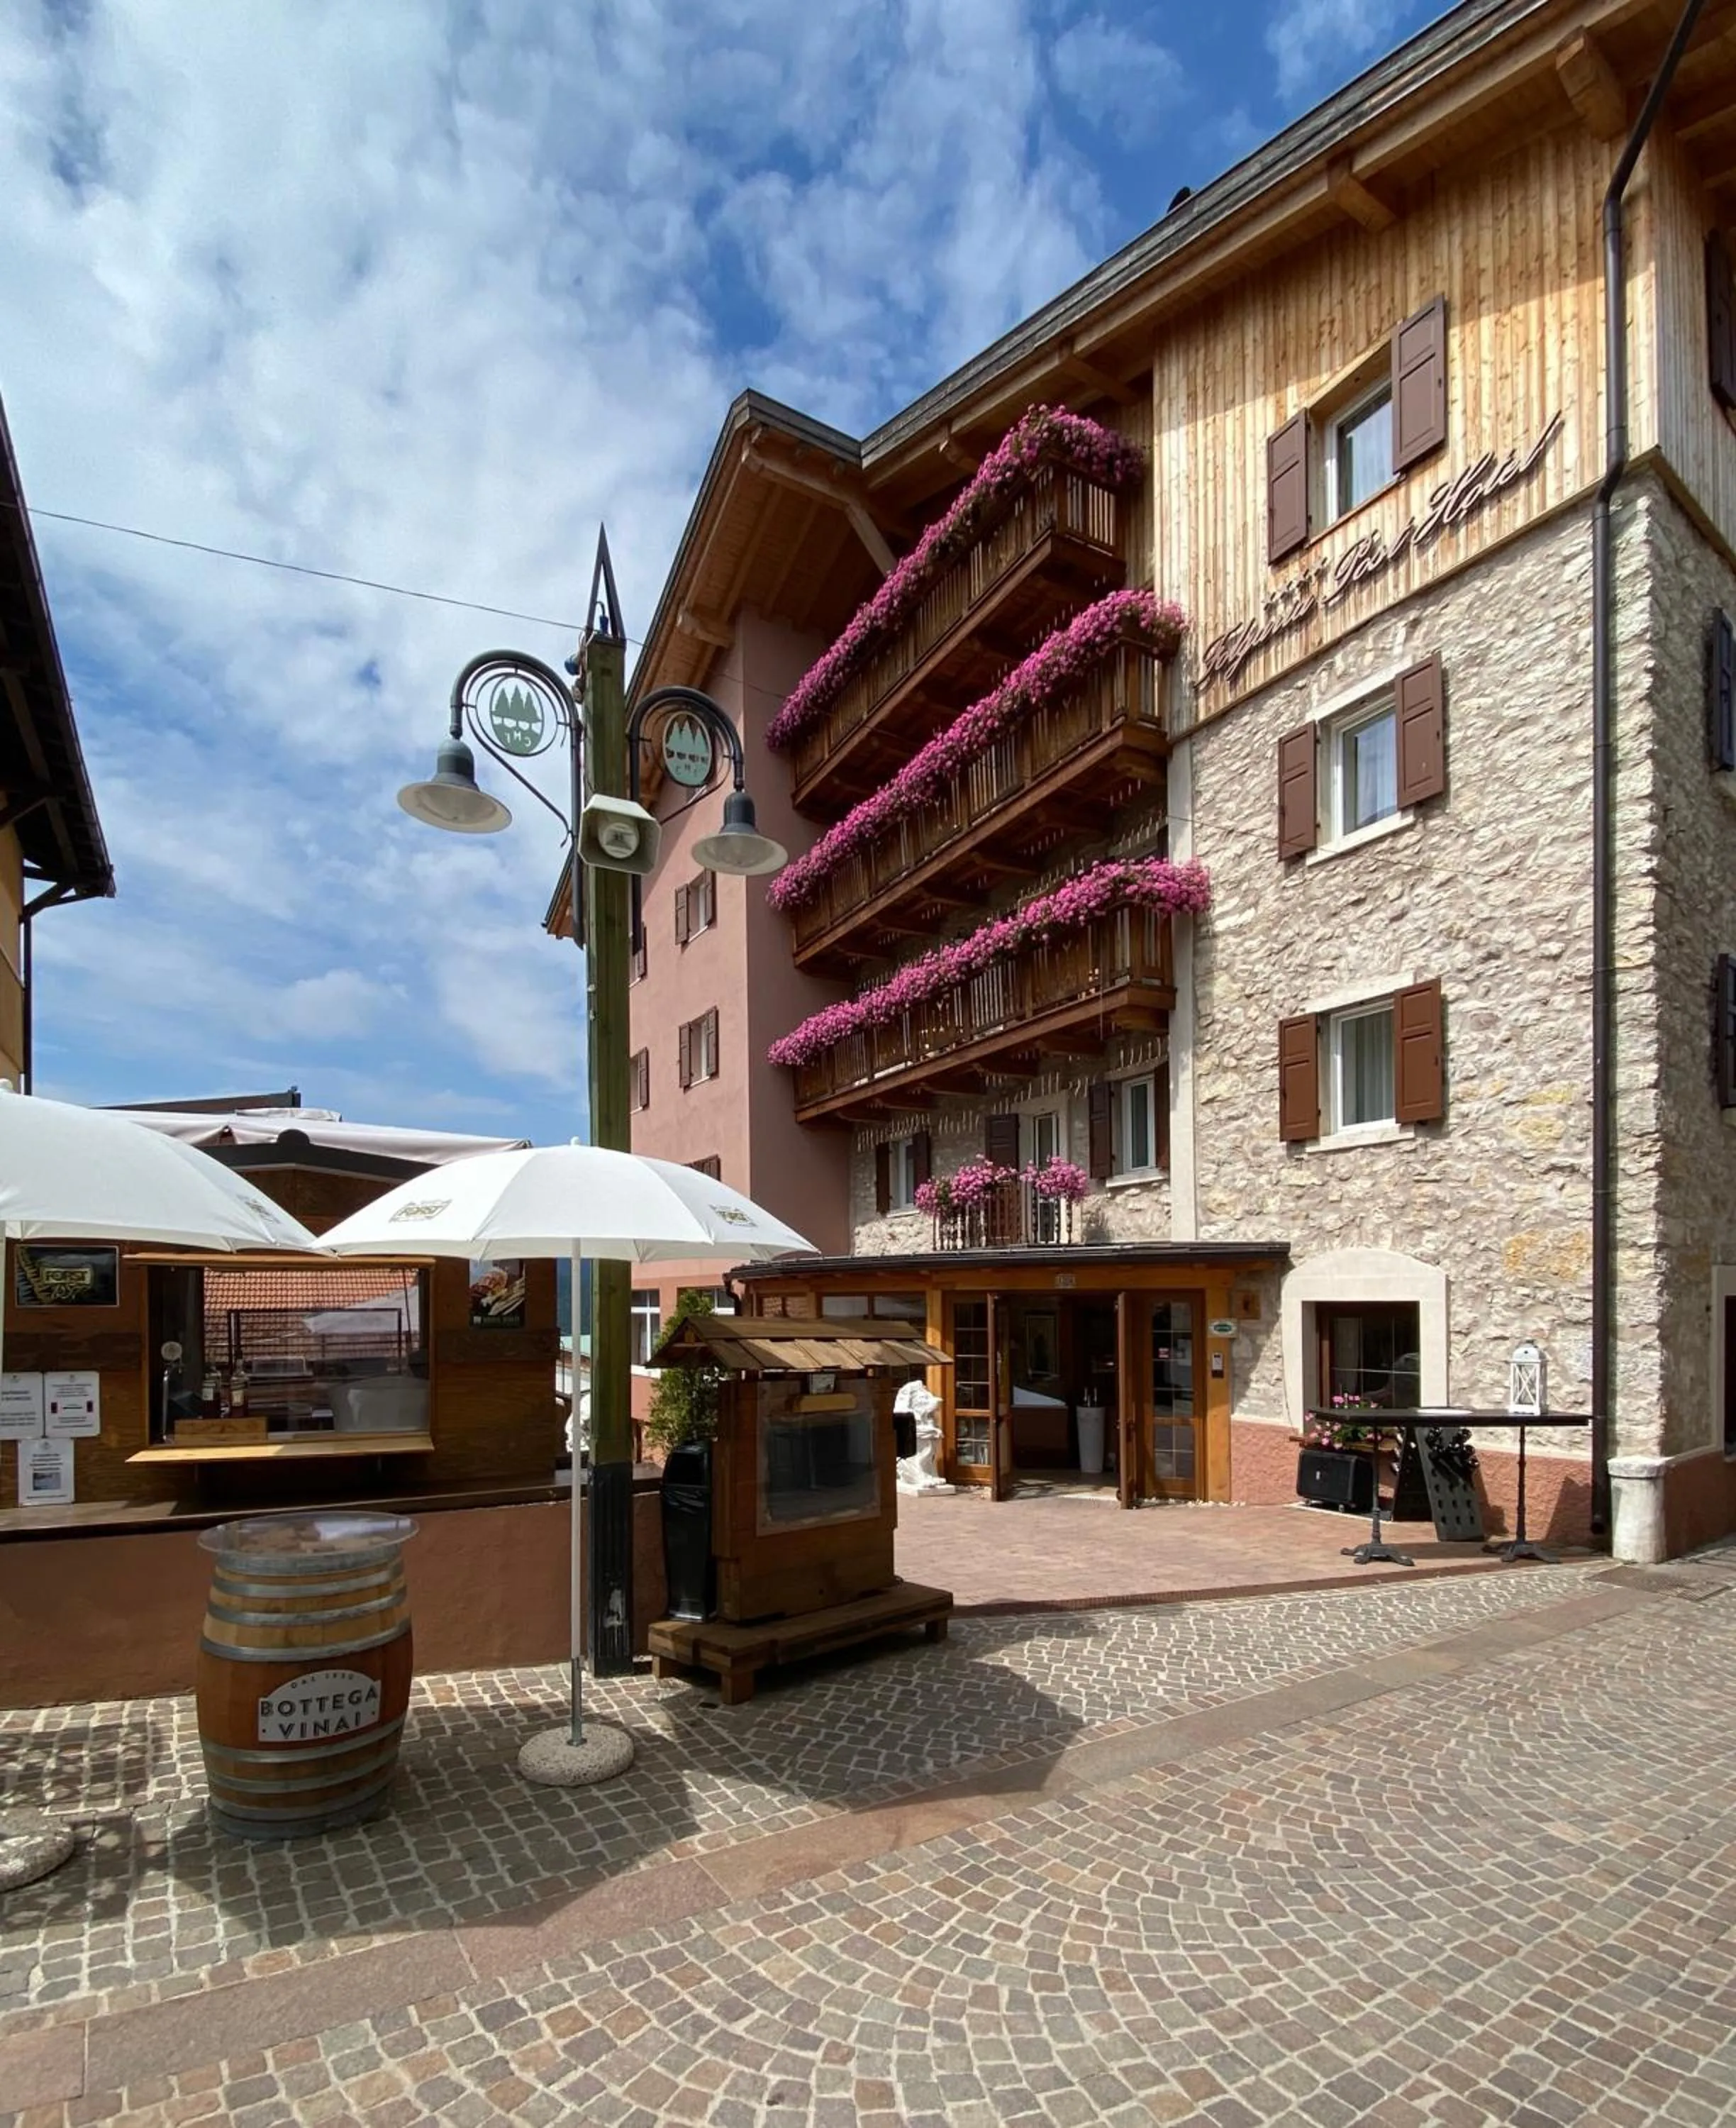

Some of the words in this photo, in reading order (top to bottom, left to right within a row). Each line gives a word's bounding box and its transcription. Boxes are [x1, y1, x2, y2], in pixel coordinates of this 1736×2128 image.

[1320, 516, 1415, 605] Post
[1412, 409, 1565, 544] Hotel
[260, 1684, 377, 1717] BOTTEGA
[278, 1711, 361, 1739] VINAI
